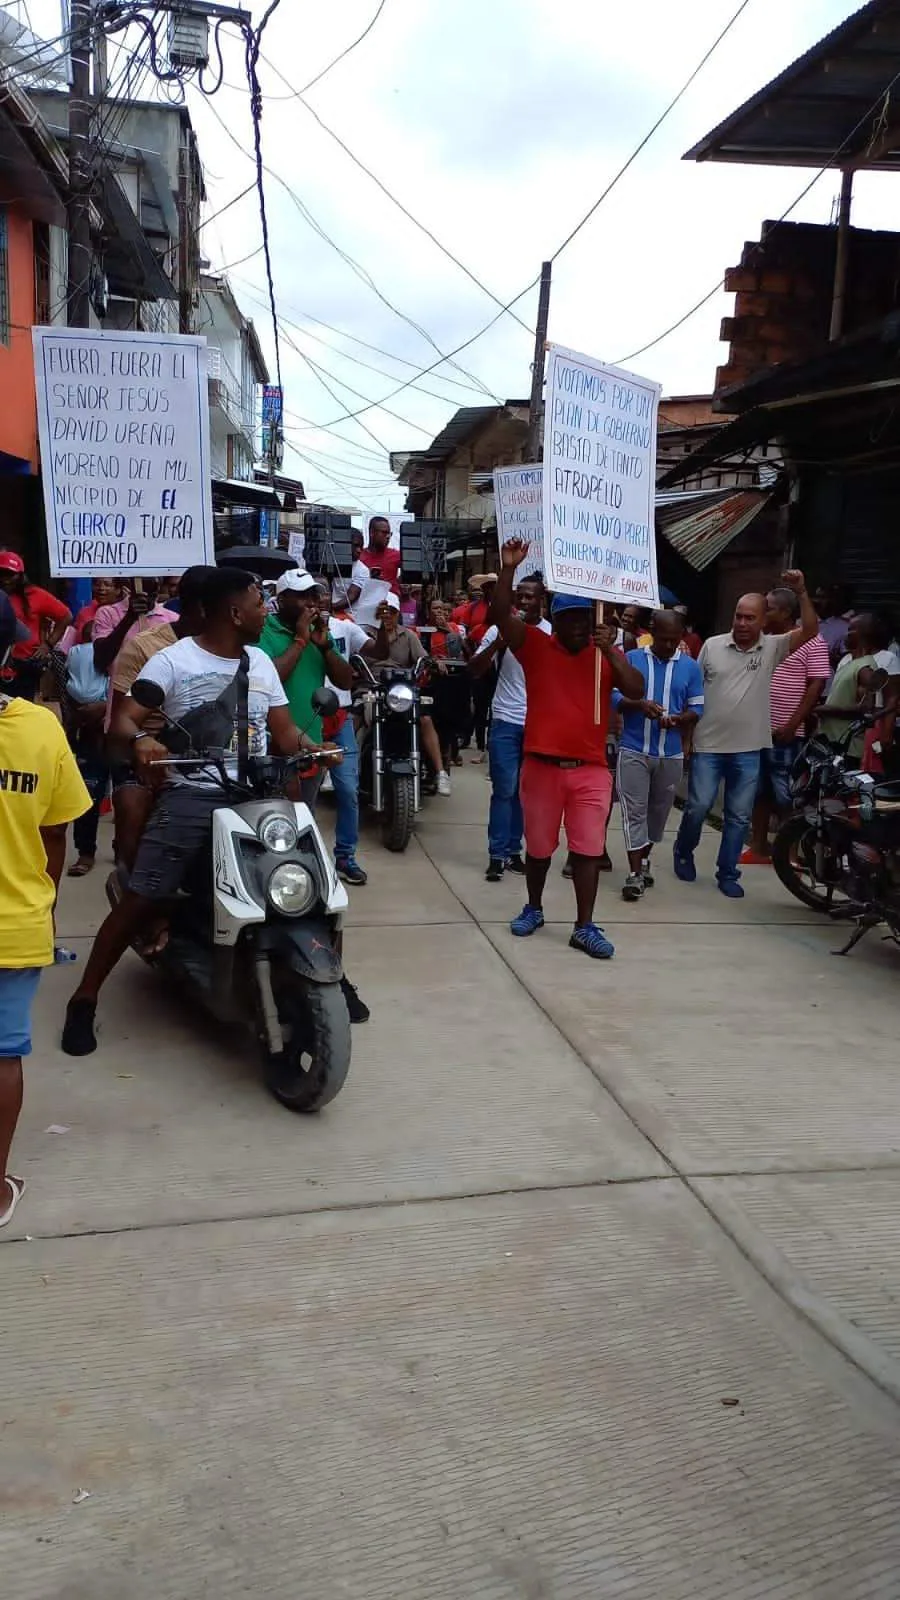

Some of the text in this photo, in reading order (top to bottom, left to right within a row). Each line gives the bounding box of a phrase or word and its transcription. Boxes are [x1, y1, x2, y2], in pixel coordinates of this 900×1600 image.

[111, 351, 161, 377] FUERA
[53, 384, 170, 413] SEÑOR JESÚS
[557, 363, 650, 421] VOTAMOS POR UN
[114, 421, 175, 447] UREÑA
[554, 397, 650, 449] PLAN DE GOBIERNO
[54, 451, 120, 479] MORENO
[552, 430, 643, 480] BASTA DE TANTO
[128, 488, 145, 508] DE
[60, 511, 193, 540] CHARCO FUERA
[552, 502, 566, 529] NI
[572, 507, 590, 533] UN
[624, 519, 650, 549] PARA
[61, 539, 138, 565] FORANEO
[553, 537, 603, 566] GUILLERMO
[556, 563, 583, 581] BASTA
[586, 569, 598, 584] YA
[602, 574, 617, 588] POR
[621, 577, 649, 594] FAVOR
